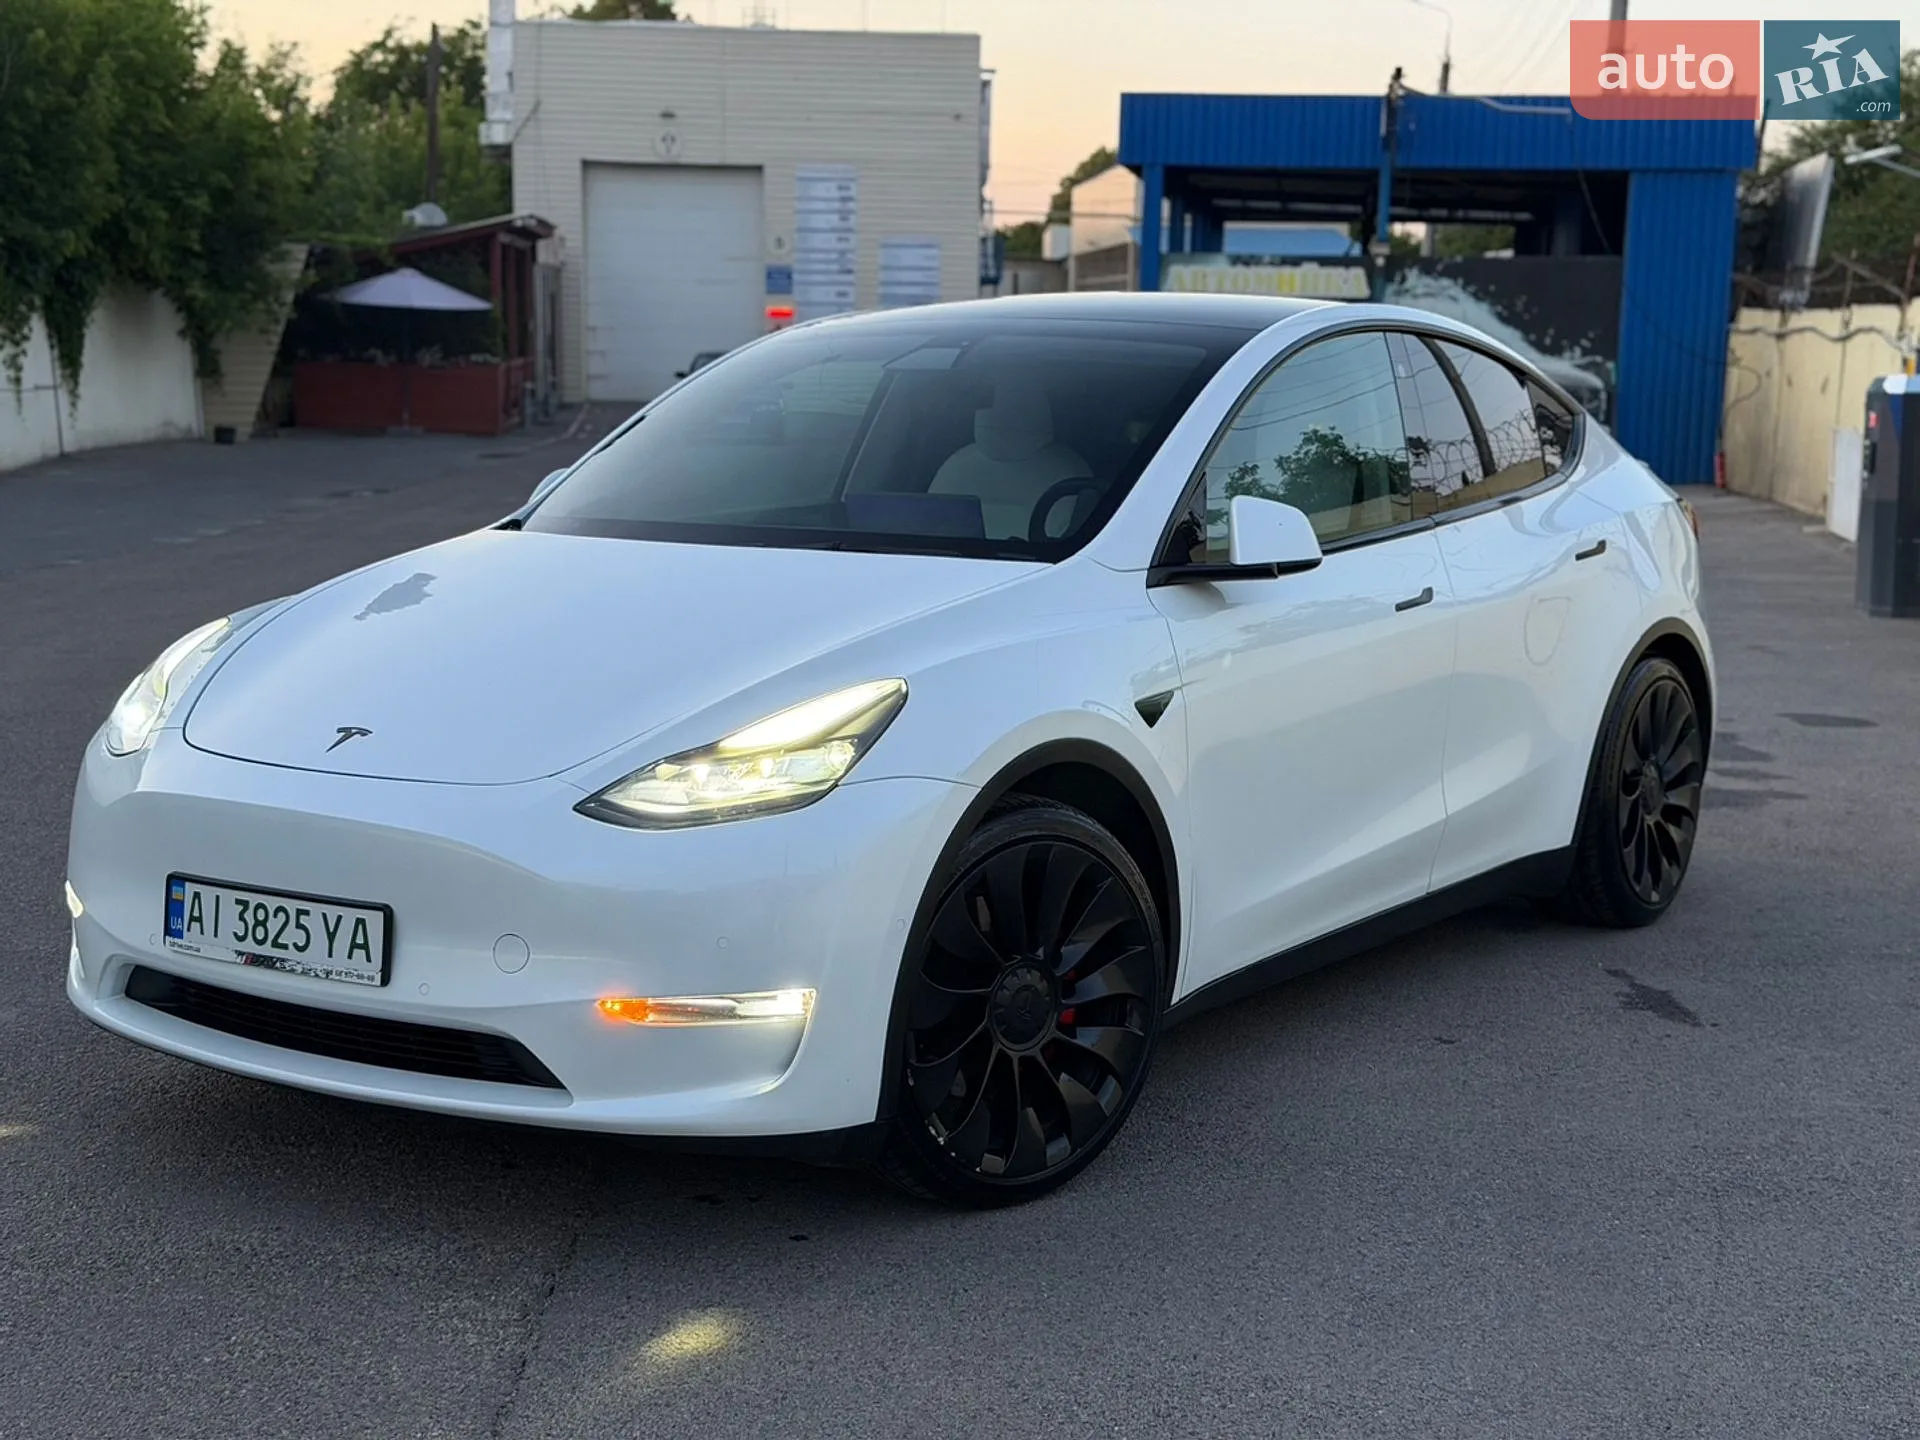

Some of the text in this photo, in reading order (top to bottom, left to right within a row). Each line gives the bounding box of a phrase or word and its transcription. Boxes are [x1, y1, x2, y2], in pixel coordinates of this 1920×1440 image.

[170, 916, 183, 931] UA
[187, 891, 372, 963] AI 3825 YA
